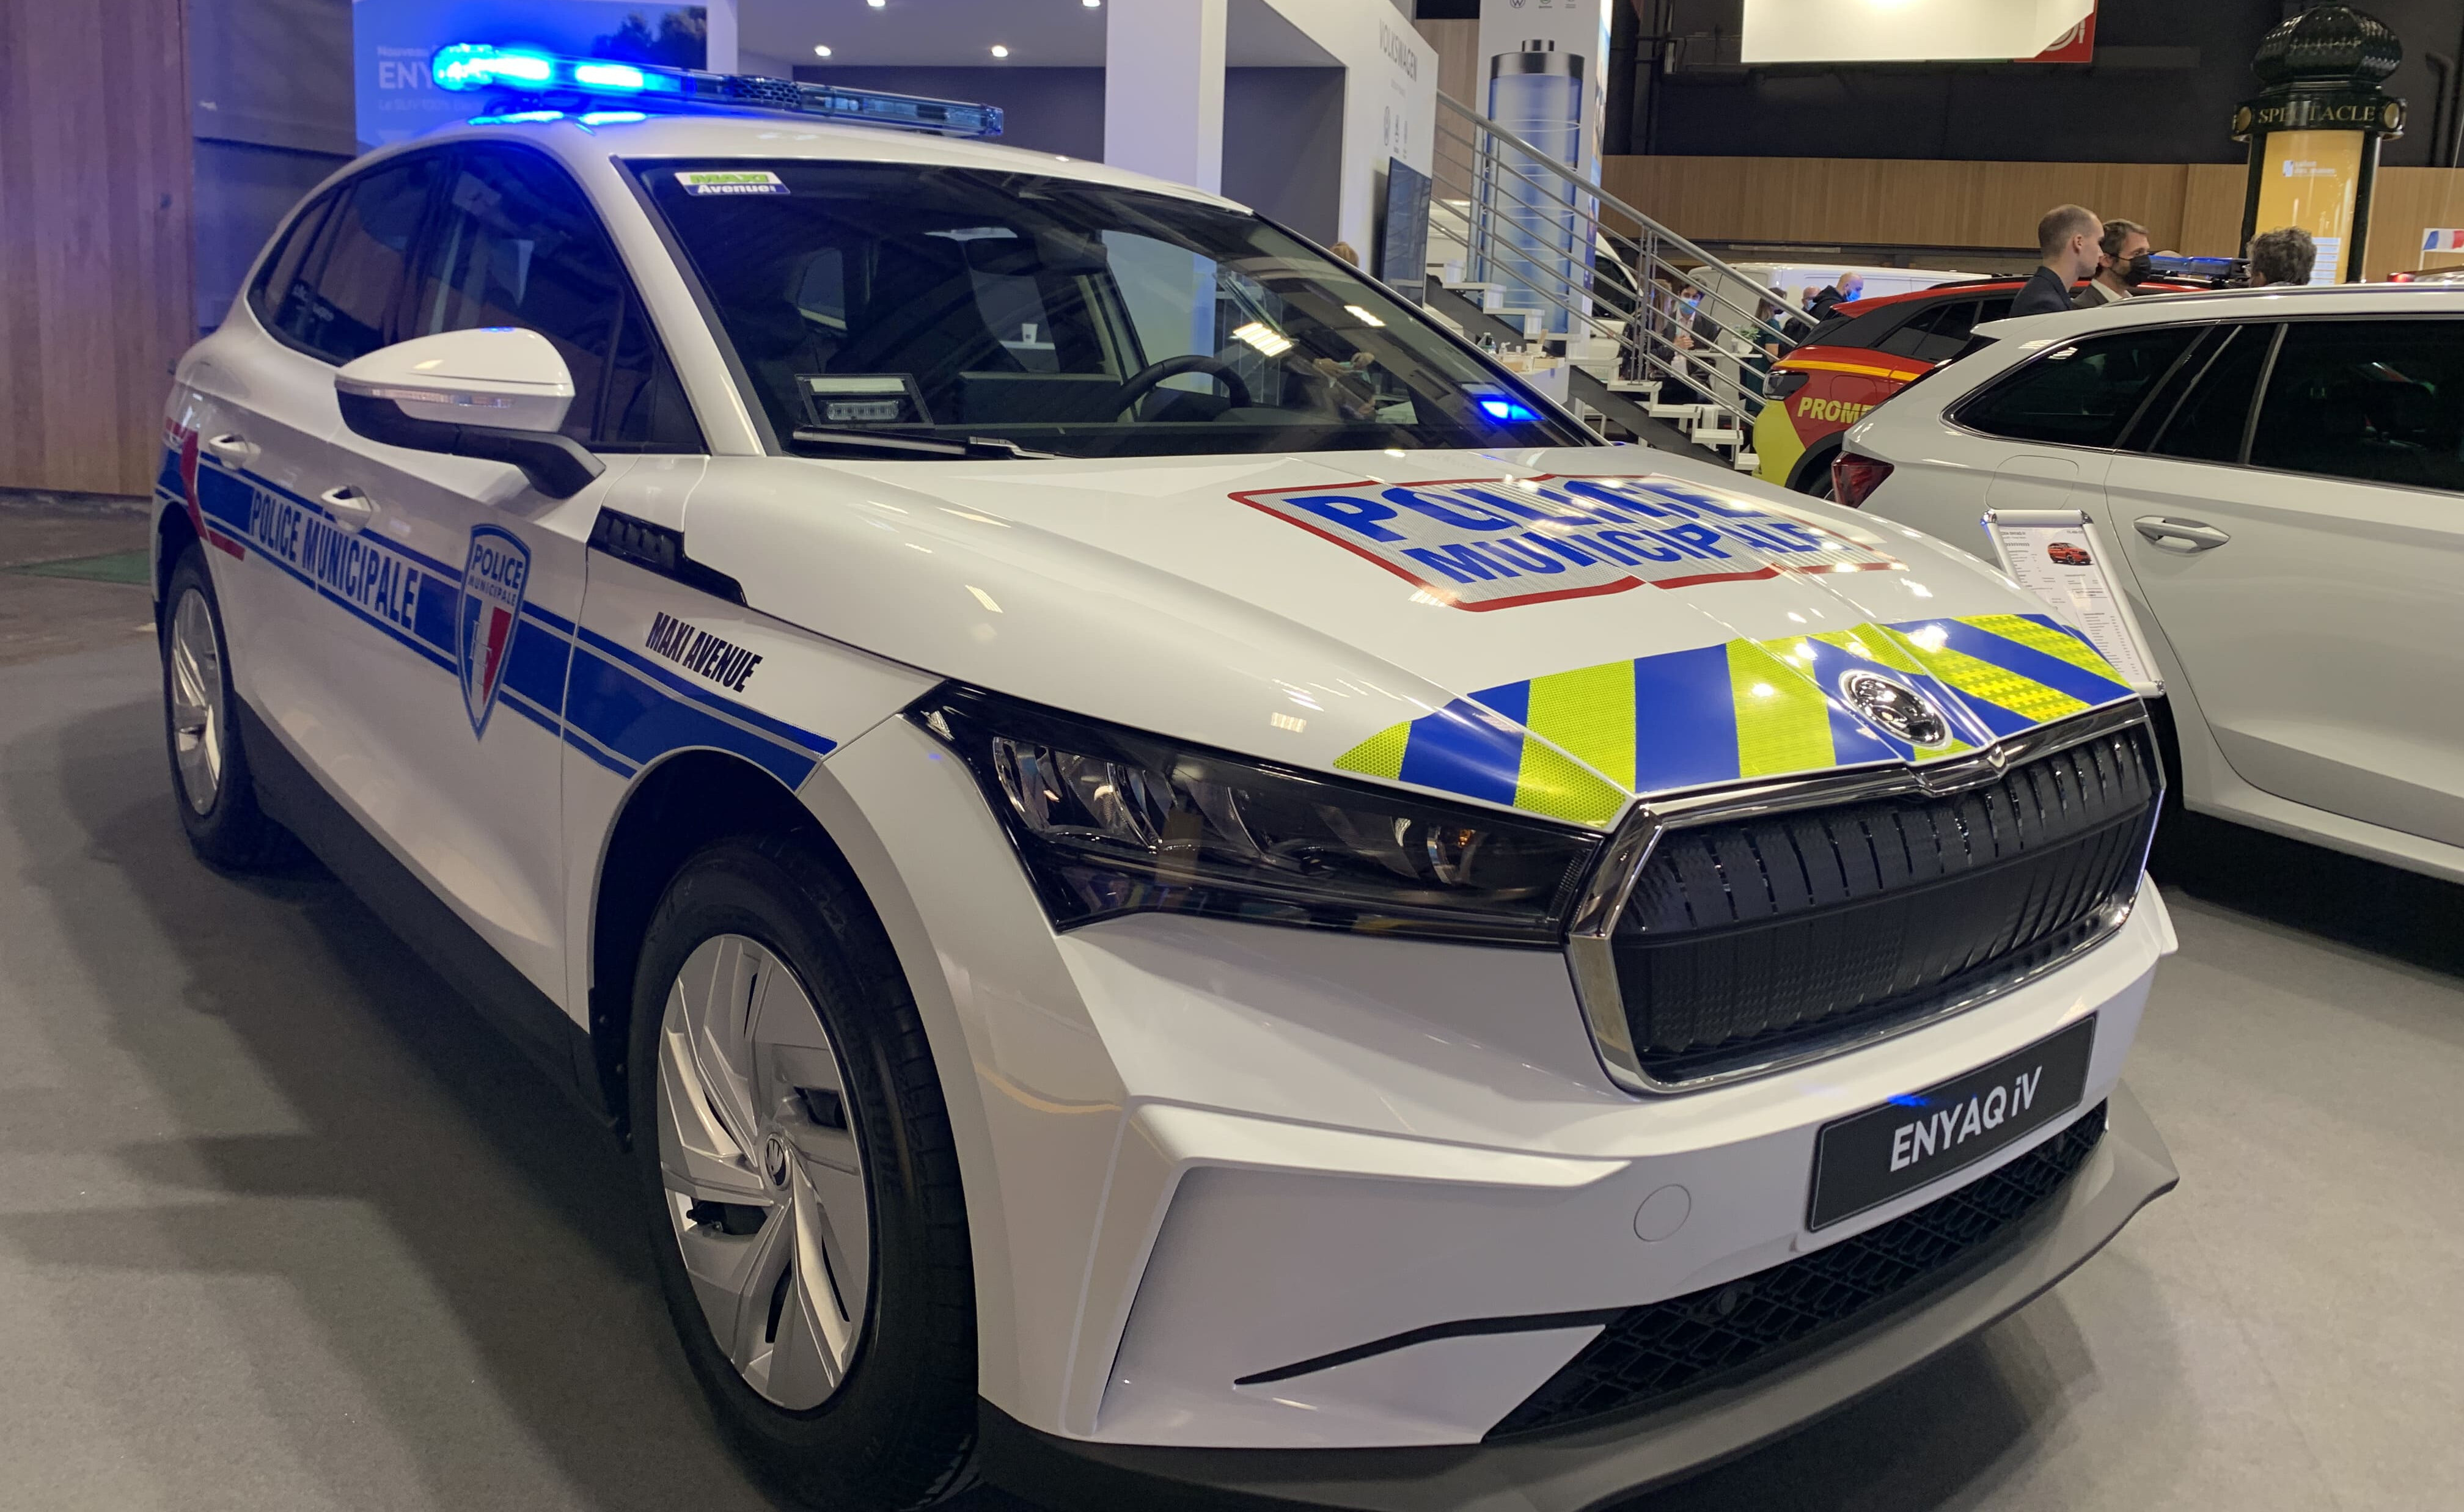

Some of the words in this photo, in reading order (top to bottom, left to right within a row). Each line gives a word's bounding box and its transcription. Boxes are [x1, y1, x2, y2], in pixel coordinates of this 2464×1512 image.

[1379, 18, 1418, 81] VOLKSWAGEN
[690, 174, 769, 183] MAXI
[1281, 480, 1772, 542] POLICE
[249, 489, 302, 563] POLICE
[302, 516, 419, 630] MUNICIPALE
[471, 543, 524, 590] POLICE
[1399, 522, 1852, 584] MUNICIPALE
[468, 575, 516, 607] MUNICIPALE
[645, 611, 695, 663] MAXI
[681, 630, 763, 693] AVENUE
[1890, 1085, 2007, 1172] ENYAQ
[2011, 1065, 2043, 1117] iV
